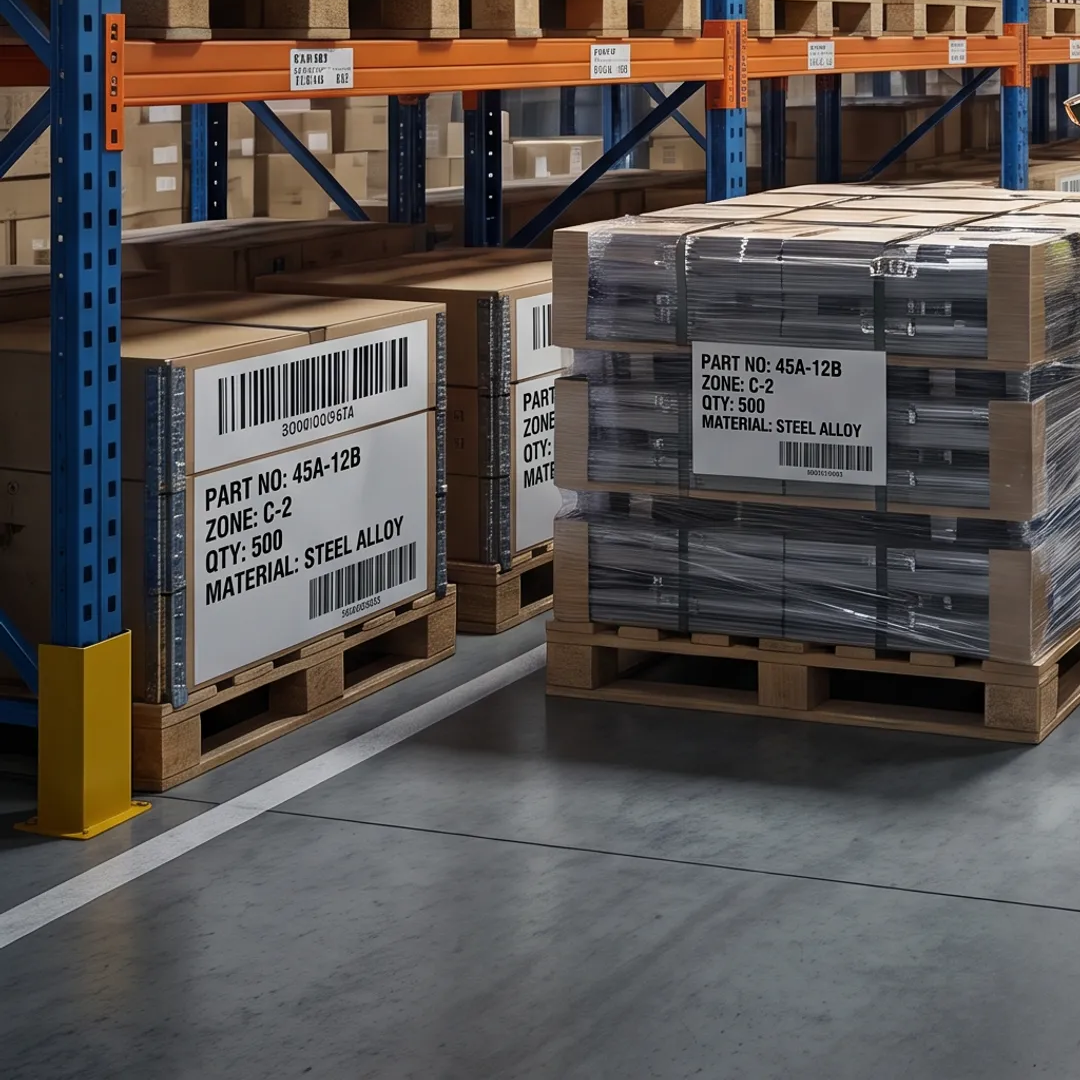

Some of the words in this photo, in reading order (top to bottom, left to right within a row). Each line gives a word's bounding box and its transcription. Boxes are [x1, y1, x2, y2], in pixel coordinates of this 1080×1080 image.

[701, 353, 740, 371] PART
[745, 356, 771, 373] NO:
[775, 358, 842, 377] 45A-12B
[702, 374, 744, 392] ZONE:
[749, 377, 774, 394] C-2
[523, 387, 555, 412] PART
[702, 395, 734, 411] QTY:
[738, 397, 765, 414] 500
[702, 414, 772, 432] MATERIAL:
[776, 419, 816, 435] STEEL
[819, 422, 862, 438] ALLOY
[205, 476, 253, 511] PART
[258, 469, 287, 495] NO:
[292, 446, 361, 484] 45A-12B
[205, 507, 258, 543] ZONE:
[264, 496, 292, 523] C-2
[206, 542, 246, 573] QTY:
[252, 529, 283, 558] 500
[206, 557, 298, 605] MATERIAL:
[304, 535, 352, 569] STEEL
[356, 515, 404, 551] ALLOY
